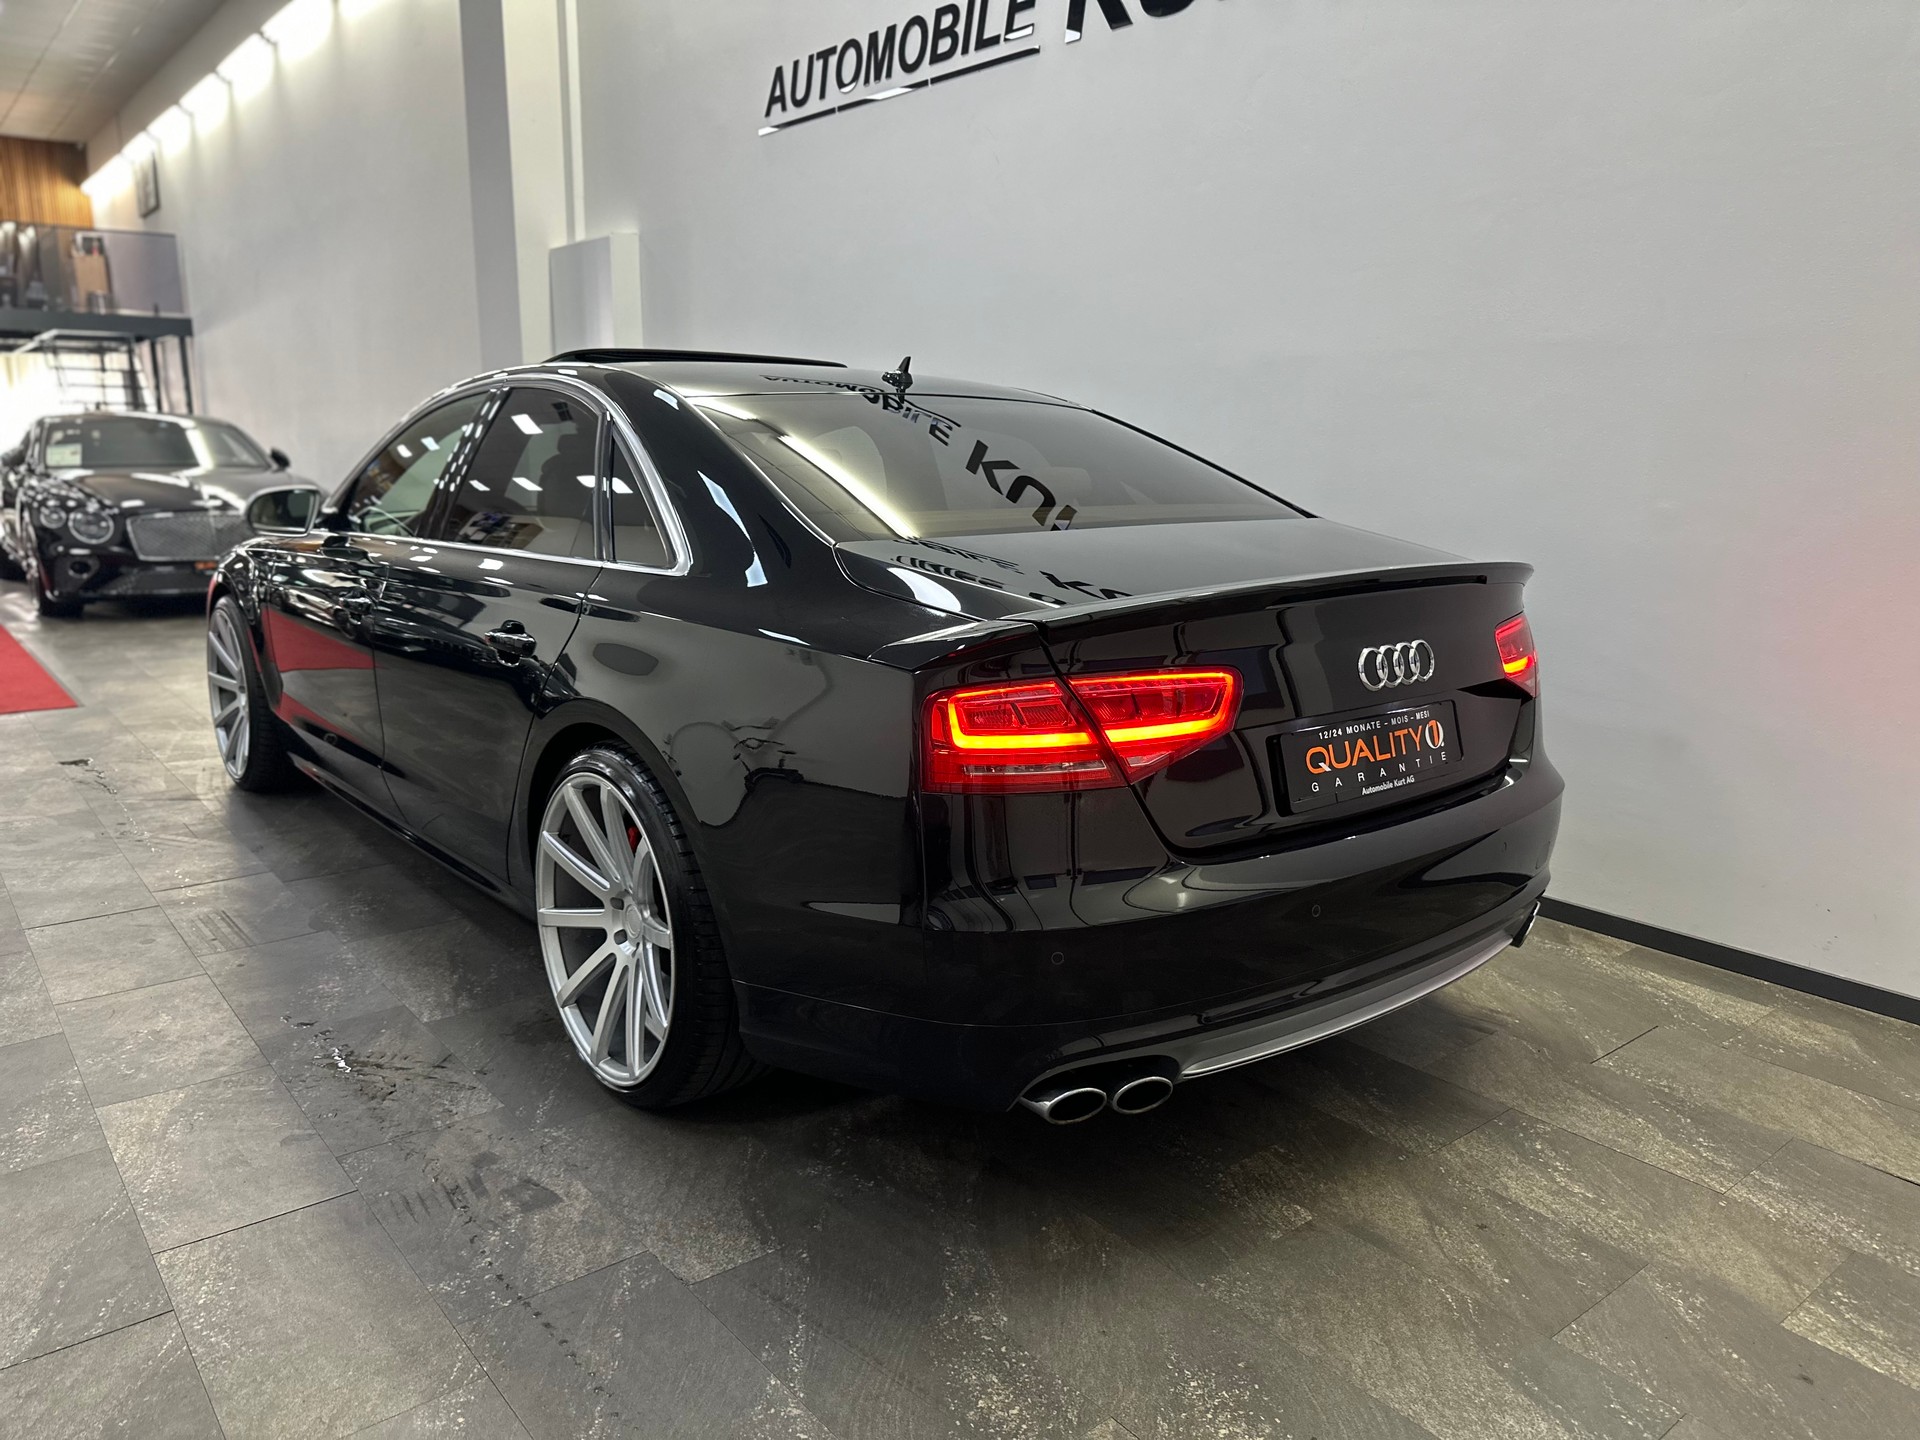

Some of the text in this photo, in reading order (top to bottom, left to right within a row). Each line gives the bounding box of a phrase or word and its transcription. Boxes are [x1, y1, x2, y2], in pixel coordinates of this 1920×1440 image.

[764, 0, 1037, 118] AUTOMOBILE
[1318, 728, 1343, 740] 12/24
[1346, 720, 1381, 735] MONATE
[1391, 715, 1409, 726] MOIS
[1415, 710, 1430, 720] MESI
[1305, 725, 1423, 775] QUALITY
[1311, 751, 1447, 792] GARANTIE
[1361, 774, 1415, 796] Automobile Kurt AG
